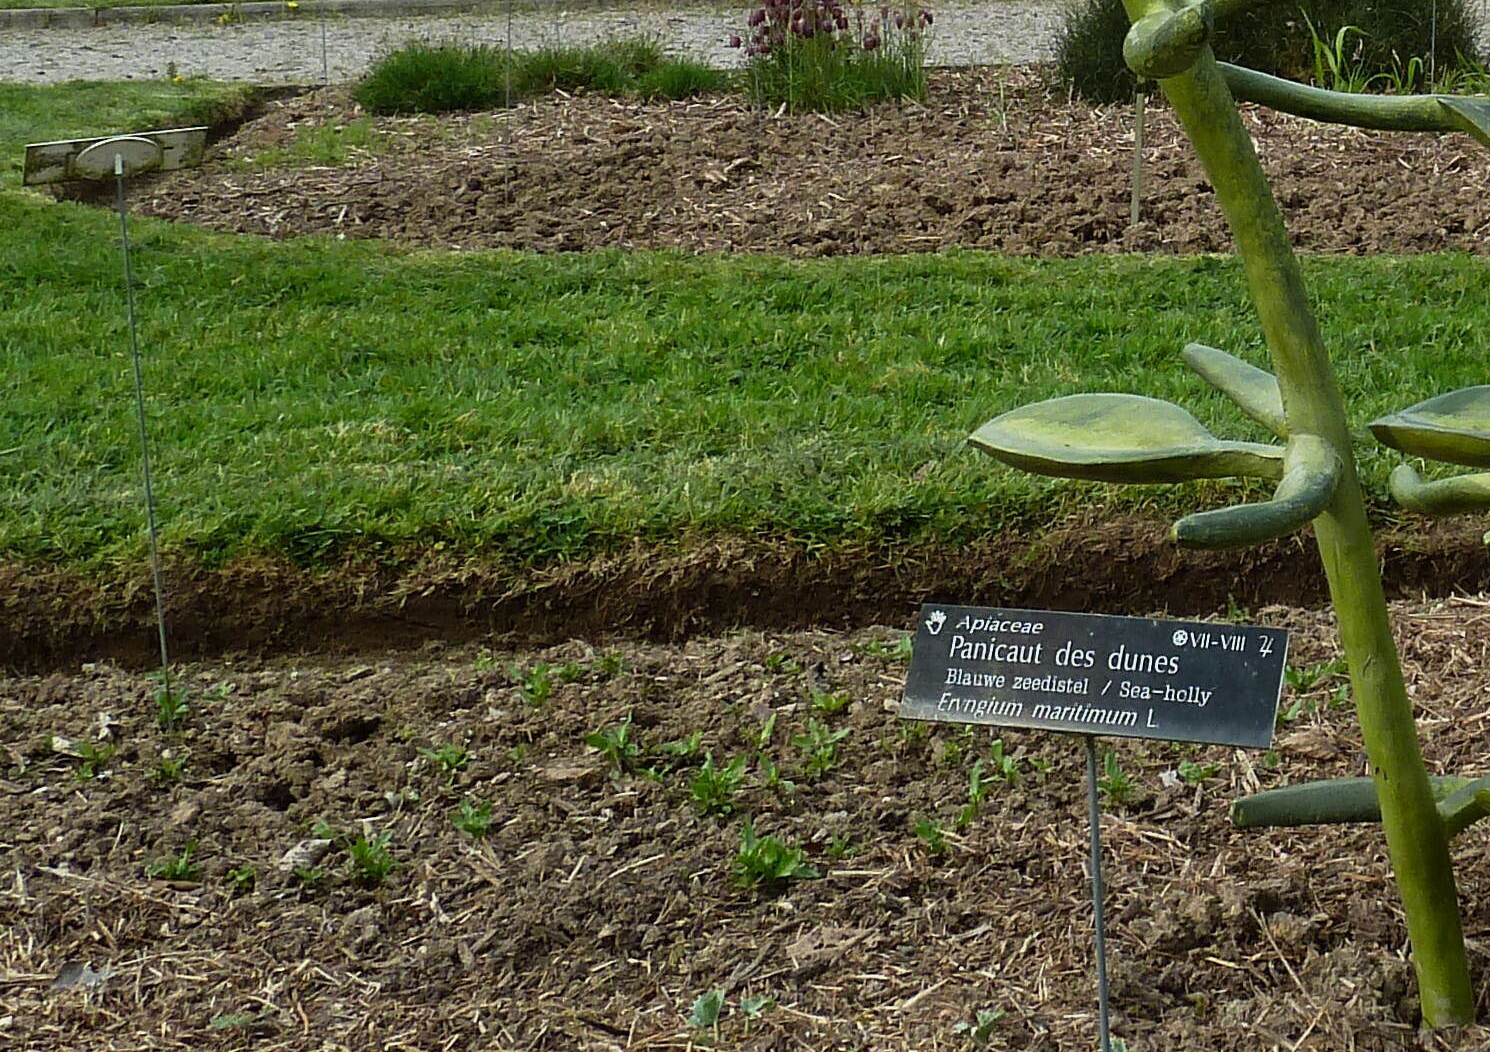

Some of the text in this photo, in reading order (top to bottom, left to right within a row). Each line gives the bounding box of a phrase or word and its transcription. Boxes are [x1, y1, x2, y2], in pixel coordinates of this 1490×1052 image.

[955, 614, 1044, 634] Apiaceae
[949, 635, 1180, 675] Panicaut des dunes
[944, 668, 1005, 688] Blauwe
[1012, 675, 1089, 695] zeedistel
[1119, 681, 1212, 707] Sea-holly
[1031, 702, 1138, 727] maritimum
